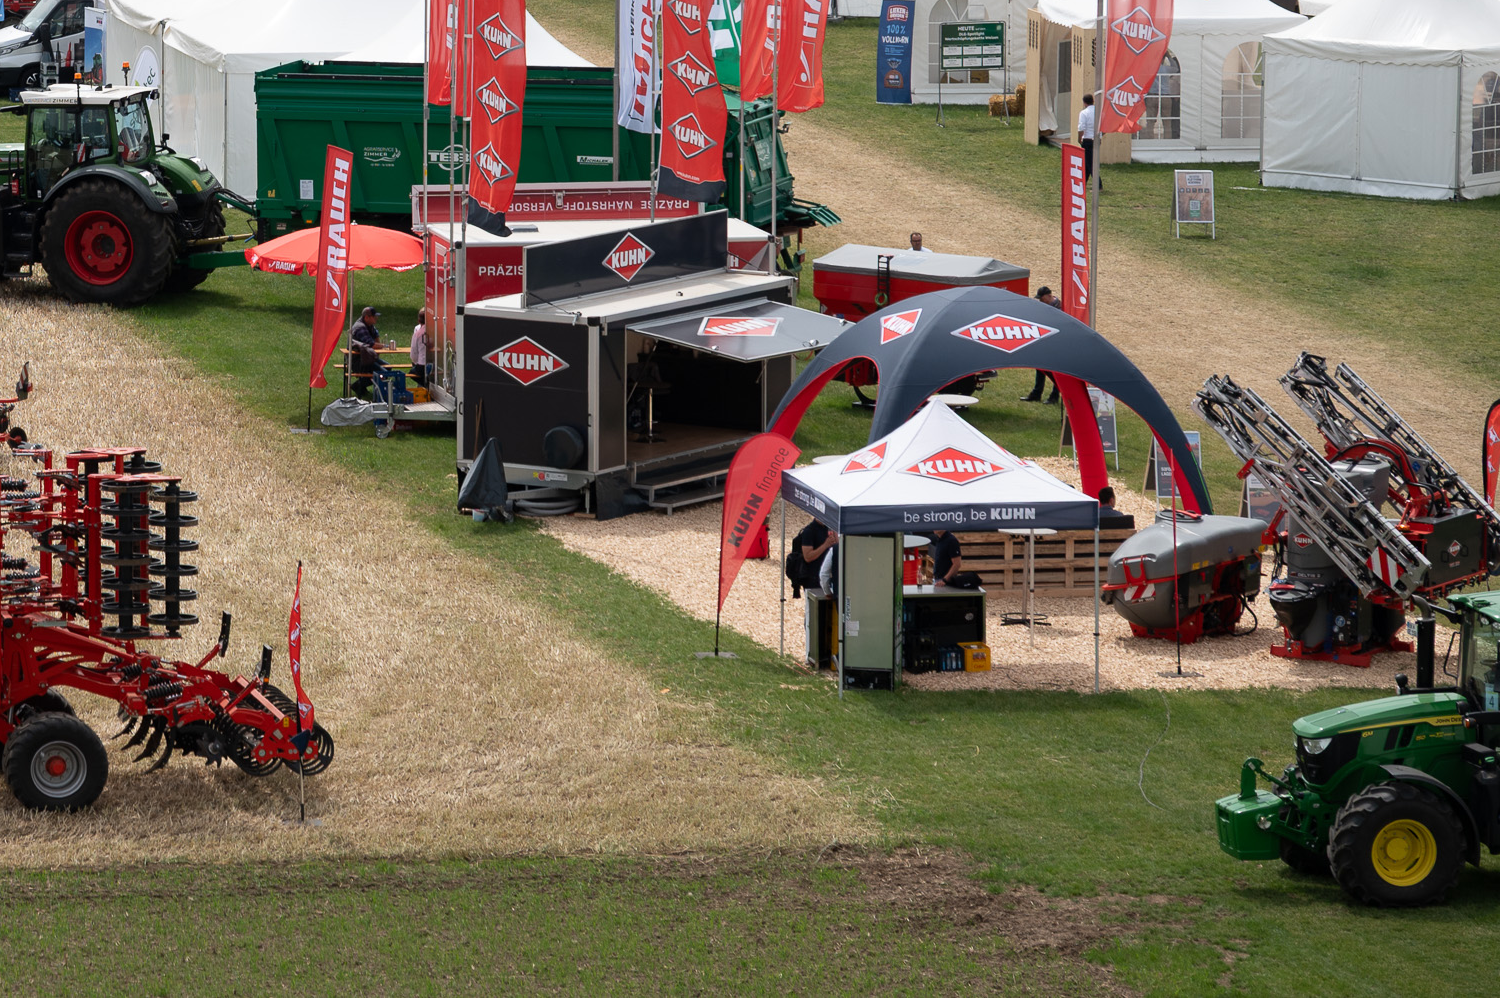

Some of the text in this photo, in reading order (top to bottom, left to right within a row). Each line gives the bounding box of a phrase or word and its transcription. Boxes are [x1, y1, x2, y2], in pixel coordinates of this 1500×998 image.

[675, 0, 701, 21] KUH
[484, 23, 512, 49] KUHN
[482, 87, 507, 113] KUHN
[1111, 88, 1140, 107] KU
[675, 124, 705, 148] KUHN
[428, 152, 470, 162] TEBB
[327, 157, 349, 269] RAUCH
[1070, 155, 1087, 266] RAUCH
[611, 247, 646, 269] KUHN
[478, 263, 524, 276] PRÄZIS
[704, 318, 776, 335] KUHN
[969, 325, 1041, 340] KUHN
[498, 351, 554, 372] KUHN
[917, 459, 994, 475] KUHN
[727, 447, 789, 548] KUHN finance
[904, 507, 1036, 524] be strong, be KUHN
